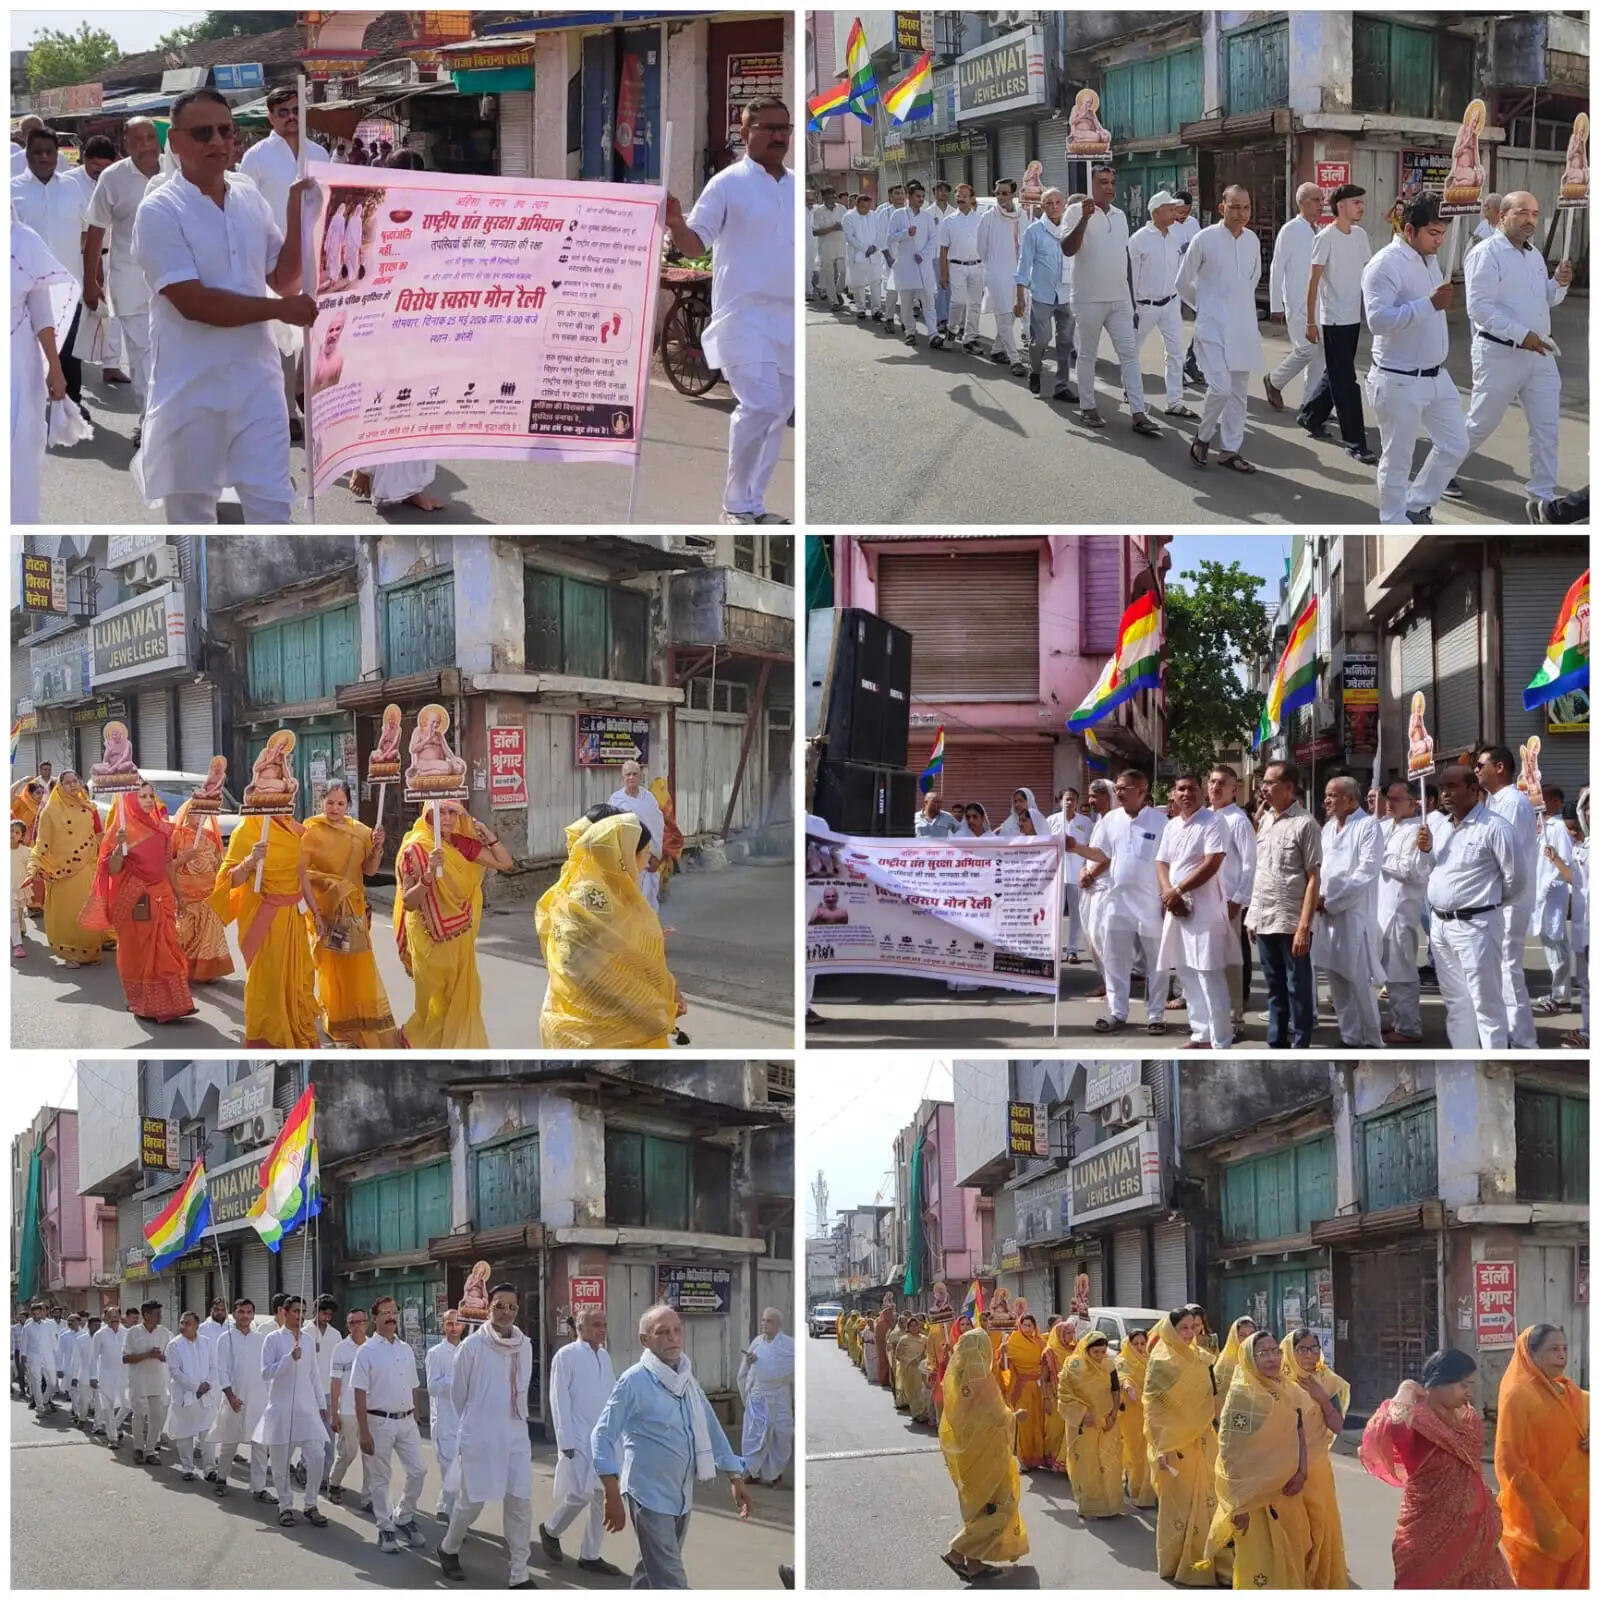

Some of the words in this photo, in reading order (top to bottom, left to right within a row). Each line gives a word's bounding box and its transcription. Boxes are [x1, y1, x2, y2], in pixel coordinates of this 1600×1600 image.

[897, 15, 920, 31] शिखर
[960, 43, 1026, 88] LUNAWAT
[973, 75, 1027, 105] JEWELLERS
[1320, 165, 1346, 182] डॉली
[422, 210, 460, 234] राष्ट्रीय
[461, 210, 482, 230] संत
[482, 215, 517, 235] सुरक्षा
[517, 213, 565, 233] अभियान
[462, 236, 473, 249] की
[490, 239, 517, 250] मानवता
[518, 237, 529, 250] की
[395, 287, 439, 312] विरोध
[484, 284, 515, 308] मौन
[515, 284, 546, 309] रैली
[25, 556, 48, 572] होटल
[25, 573, 50, 590] शिखर
[95, 603, 165, 650] LUNAWAT
[108, 635, 166, 669] JEWELLERS
[1344, 664, 1377, 677] अनिकेत
[1346, 676, 1375, 689] ज्वेलर्स
[493, 731, 520, 748] डॉली
[878, 857, 906, 868] राष्ट्रीय
[910, 857, 925, 868] संत
[927, 858, 952, 871] सुरक्षा
[955, 857, 992, 868] अभियान
[943, 895, 967, 909] मौन
[970, 895, 992, 910] रैली
[1010, 1103, 1031, 1119] होटल
[143, 1118, 164, 1134] होटल
[1010, 1121, 1034, 1136] शिखर
[143, 1135, 166, 1150] शिखर
[1074, 1141, 1139, 1191] LUNAWAT
[211, 1165, 260, 1202] UNAWA
[1086, 1175, 1140, 1208] JEWELLERS
[1480, 1266, 1510, 1285] डॉली
[575, 1281, 600, 1297] डॉली
